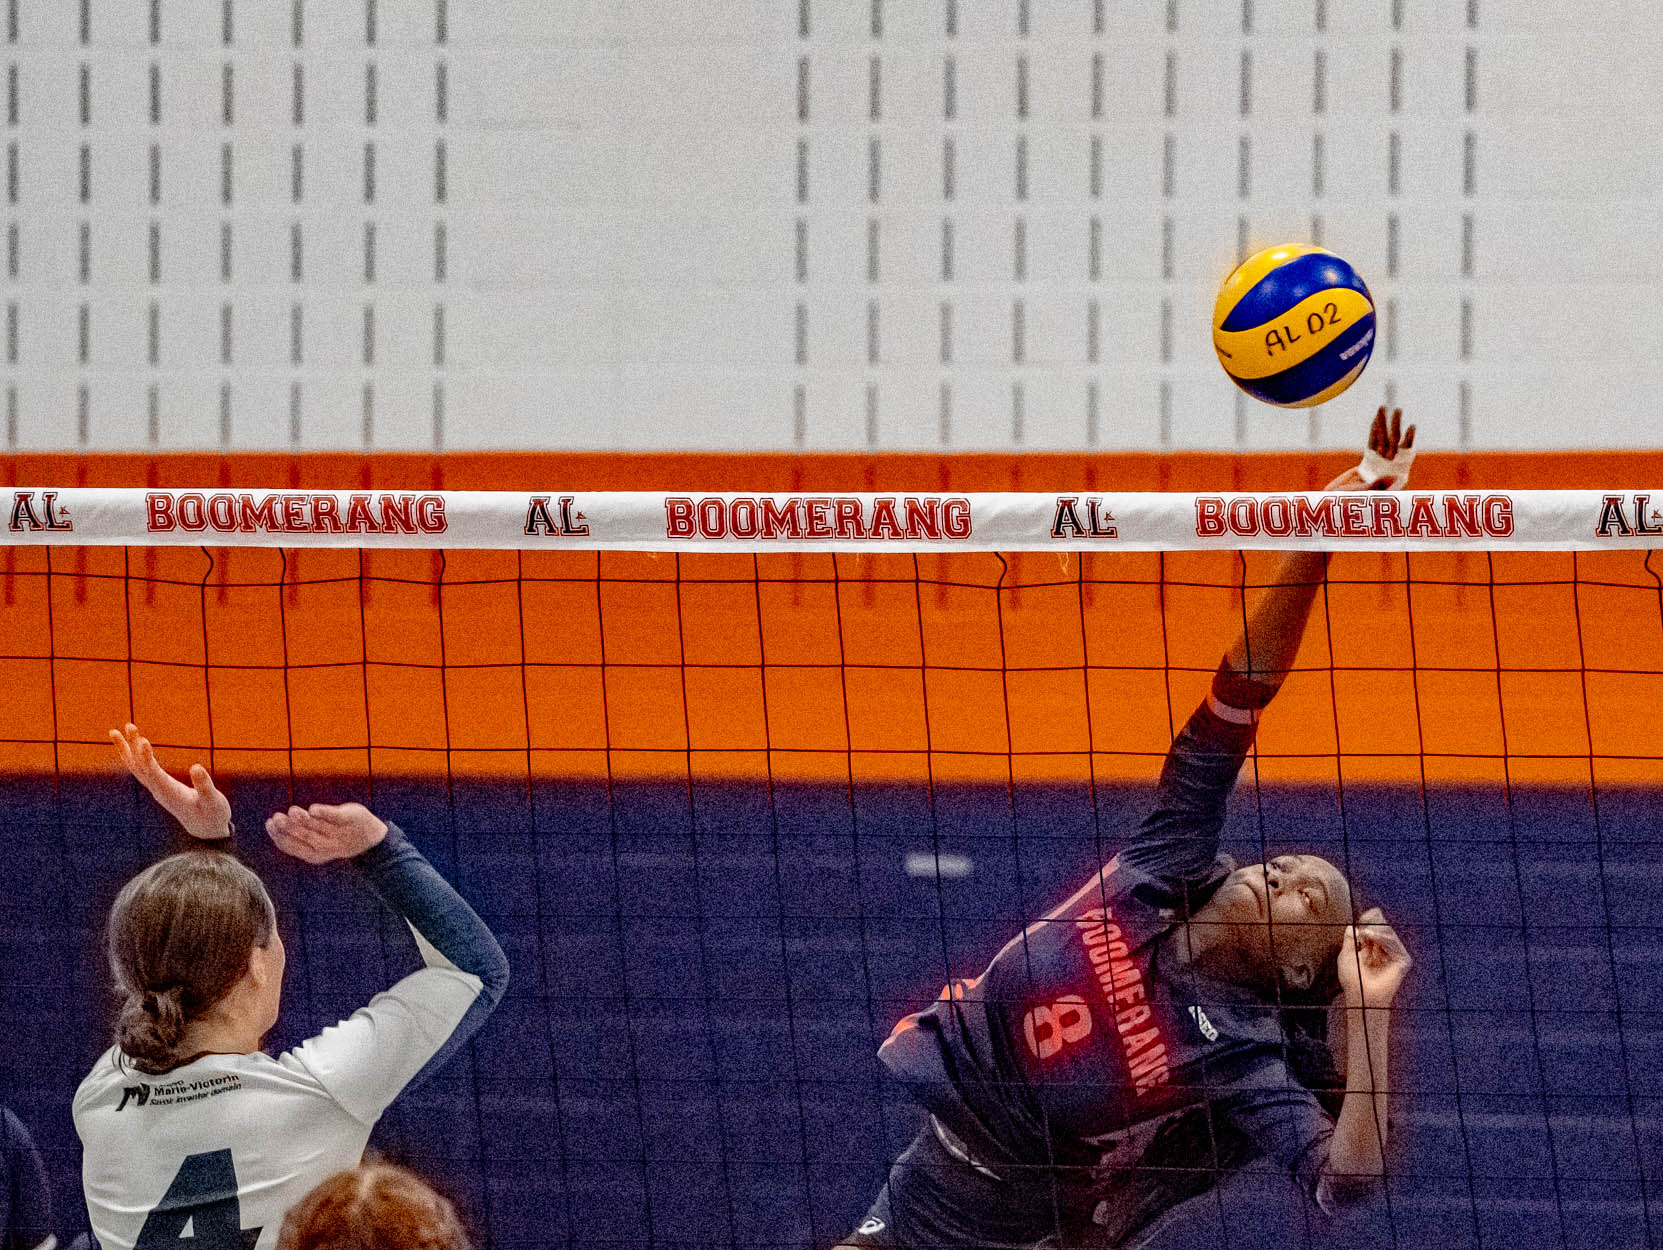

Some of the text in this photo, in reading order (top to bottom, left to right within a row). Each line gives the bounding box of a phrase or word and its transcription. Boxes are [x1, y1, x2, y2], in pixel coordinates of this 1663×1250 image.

[1265, 325, 1302, 357] AL
[8, 491, 1663, 540] AL BOOMERANG AL BOOMERANG AL BOOMERANG AL
[1023, 994, 1092, 1060] 8
[153, 1074, 240, 1098] Marie-Victorin
